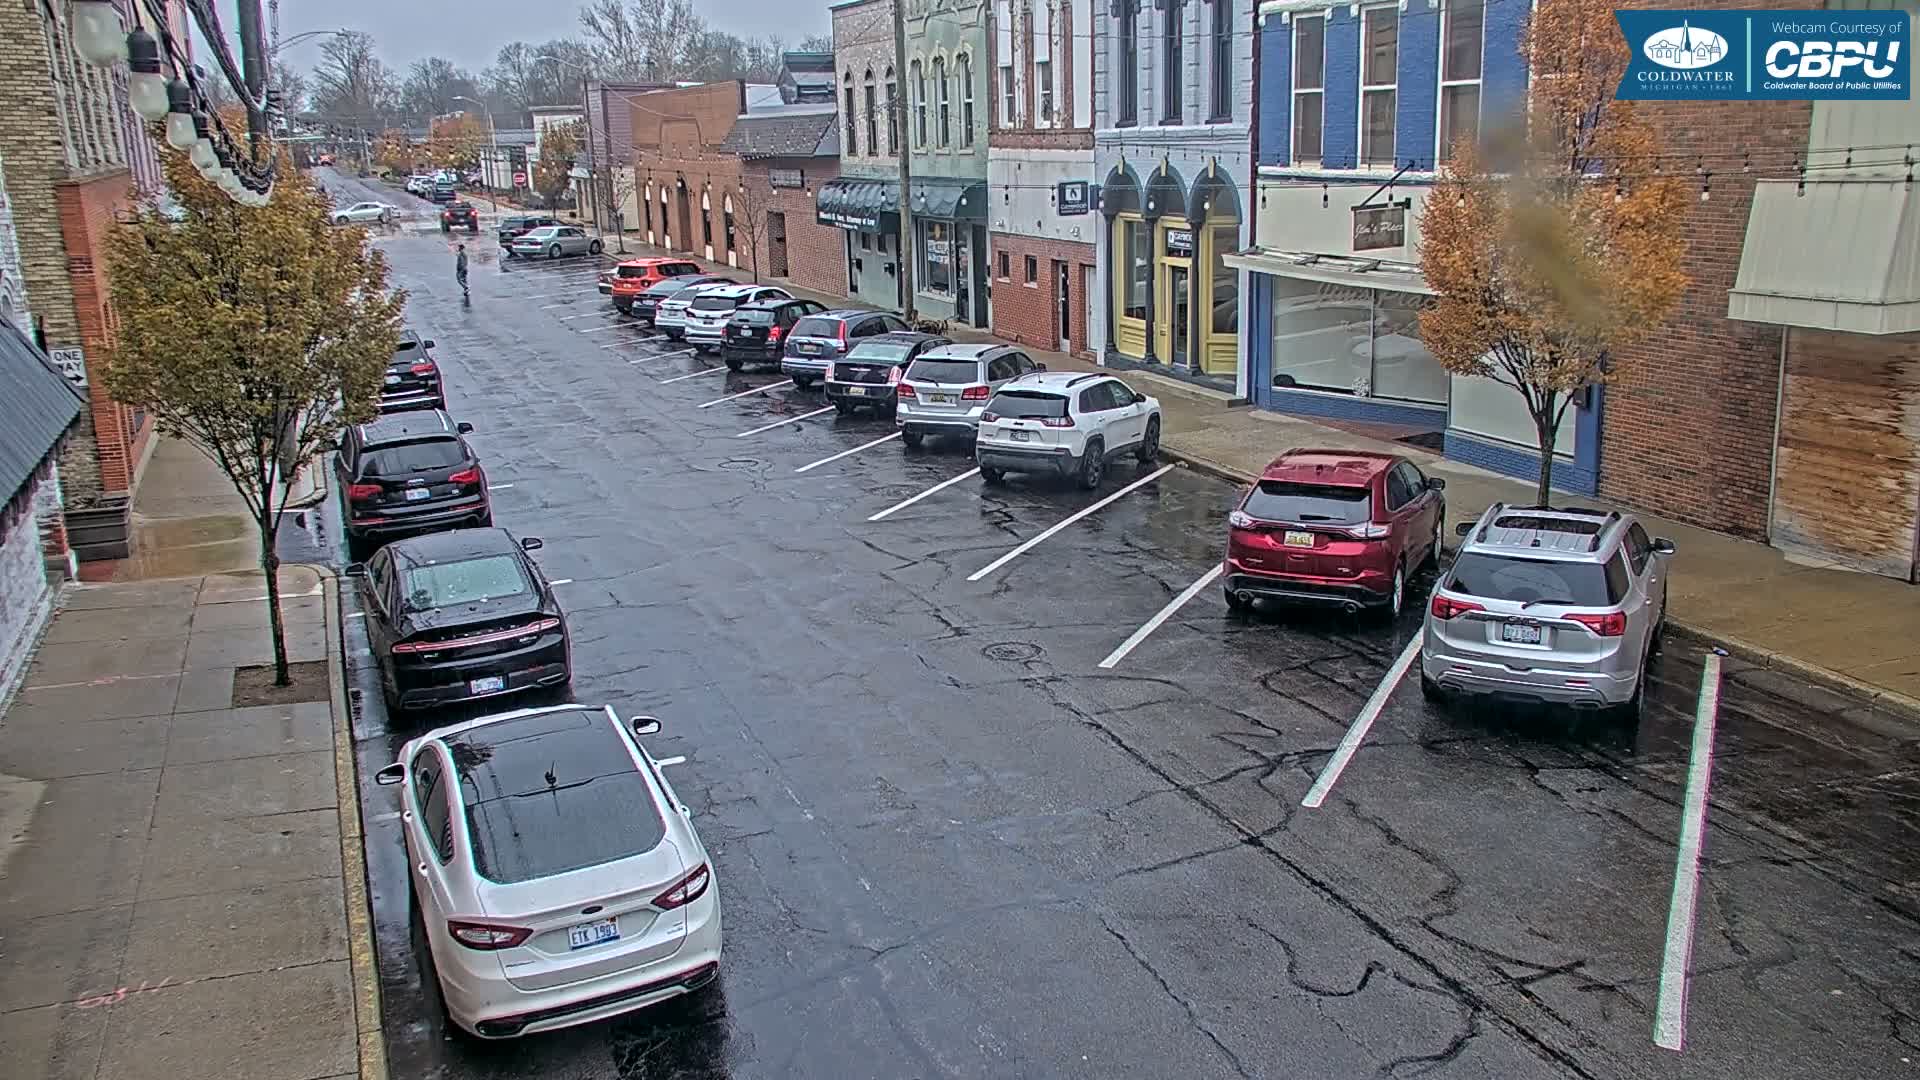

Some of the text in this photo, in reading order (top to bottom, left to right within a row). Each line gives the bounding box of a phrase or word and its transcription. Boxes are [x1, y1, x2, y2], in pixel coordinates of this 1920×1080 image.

[1354, 222, 1404, 239] Jim's Place
[53, 351, 80, 361] ONE
[572, 929, 590, 945] ETK
